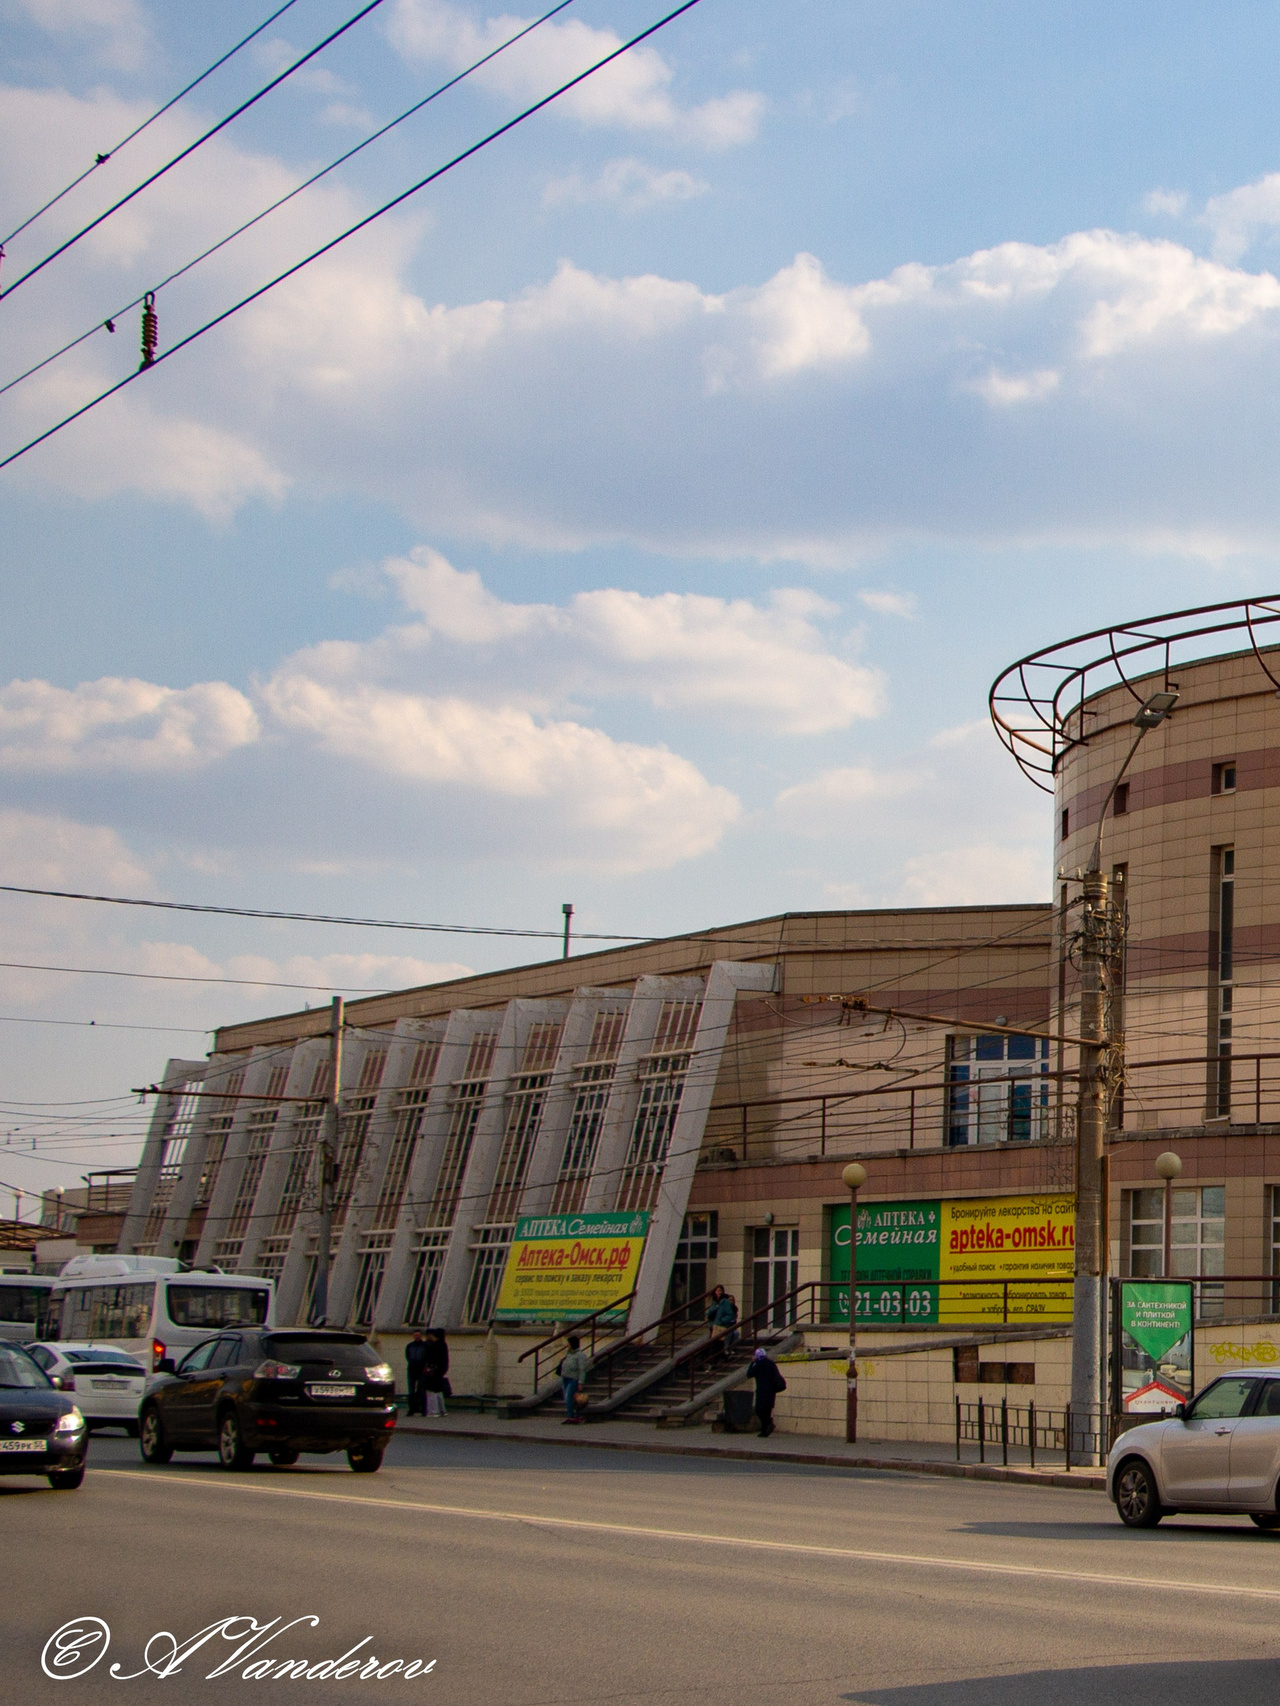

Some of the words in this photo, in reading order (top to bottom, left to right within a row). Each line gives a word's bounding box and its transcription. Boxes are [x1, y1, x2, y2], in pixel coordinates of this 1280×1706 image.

[873, 1210, 926, 1227] АПТЕКА
[951, 1206, 997, 1221] Бронируйте
[998, 1205, 1040, 1219] лекарства
[1042, 1204, 1053, 1215] на
[519, 1219, 567, 1238] АПТЕКА
[568, 1218, 628, 1236] Семейная
[834, 1225, 938, 1247] Семейная
[950, 1220, 1075, 1254] apteka-omsk.ru
[517, 1240, 632, 1272] Аптека-Омск.рф
[953, 1262, 977, 1273] удобный
[978, 1263, 996, 1271] поиск
[1002, 1263, 1029, 1272] гарантия
[1030, 1262, 1055, 1270] наличия
[1056, 1262, 1075, 1272] товар
[592, 1273, 623, 1286] лекарств
[841, 1270, 870, 1281] ТЕФОН
[1002, 1289, 1048, 1301] збронировать
[854, 1290, 932, 1317] 21-03-03
[1137, 1301, 1187, 1310] САНТЕХНИКОЙ
[1142, 1310, 1175, 1319] ПЛИТКОЙ
[1137, 1321, 1180, 1329] КОНТИНЕНТ!
[0, 1441, 32, 1451] 459РК
